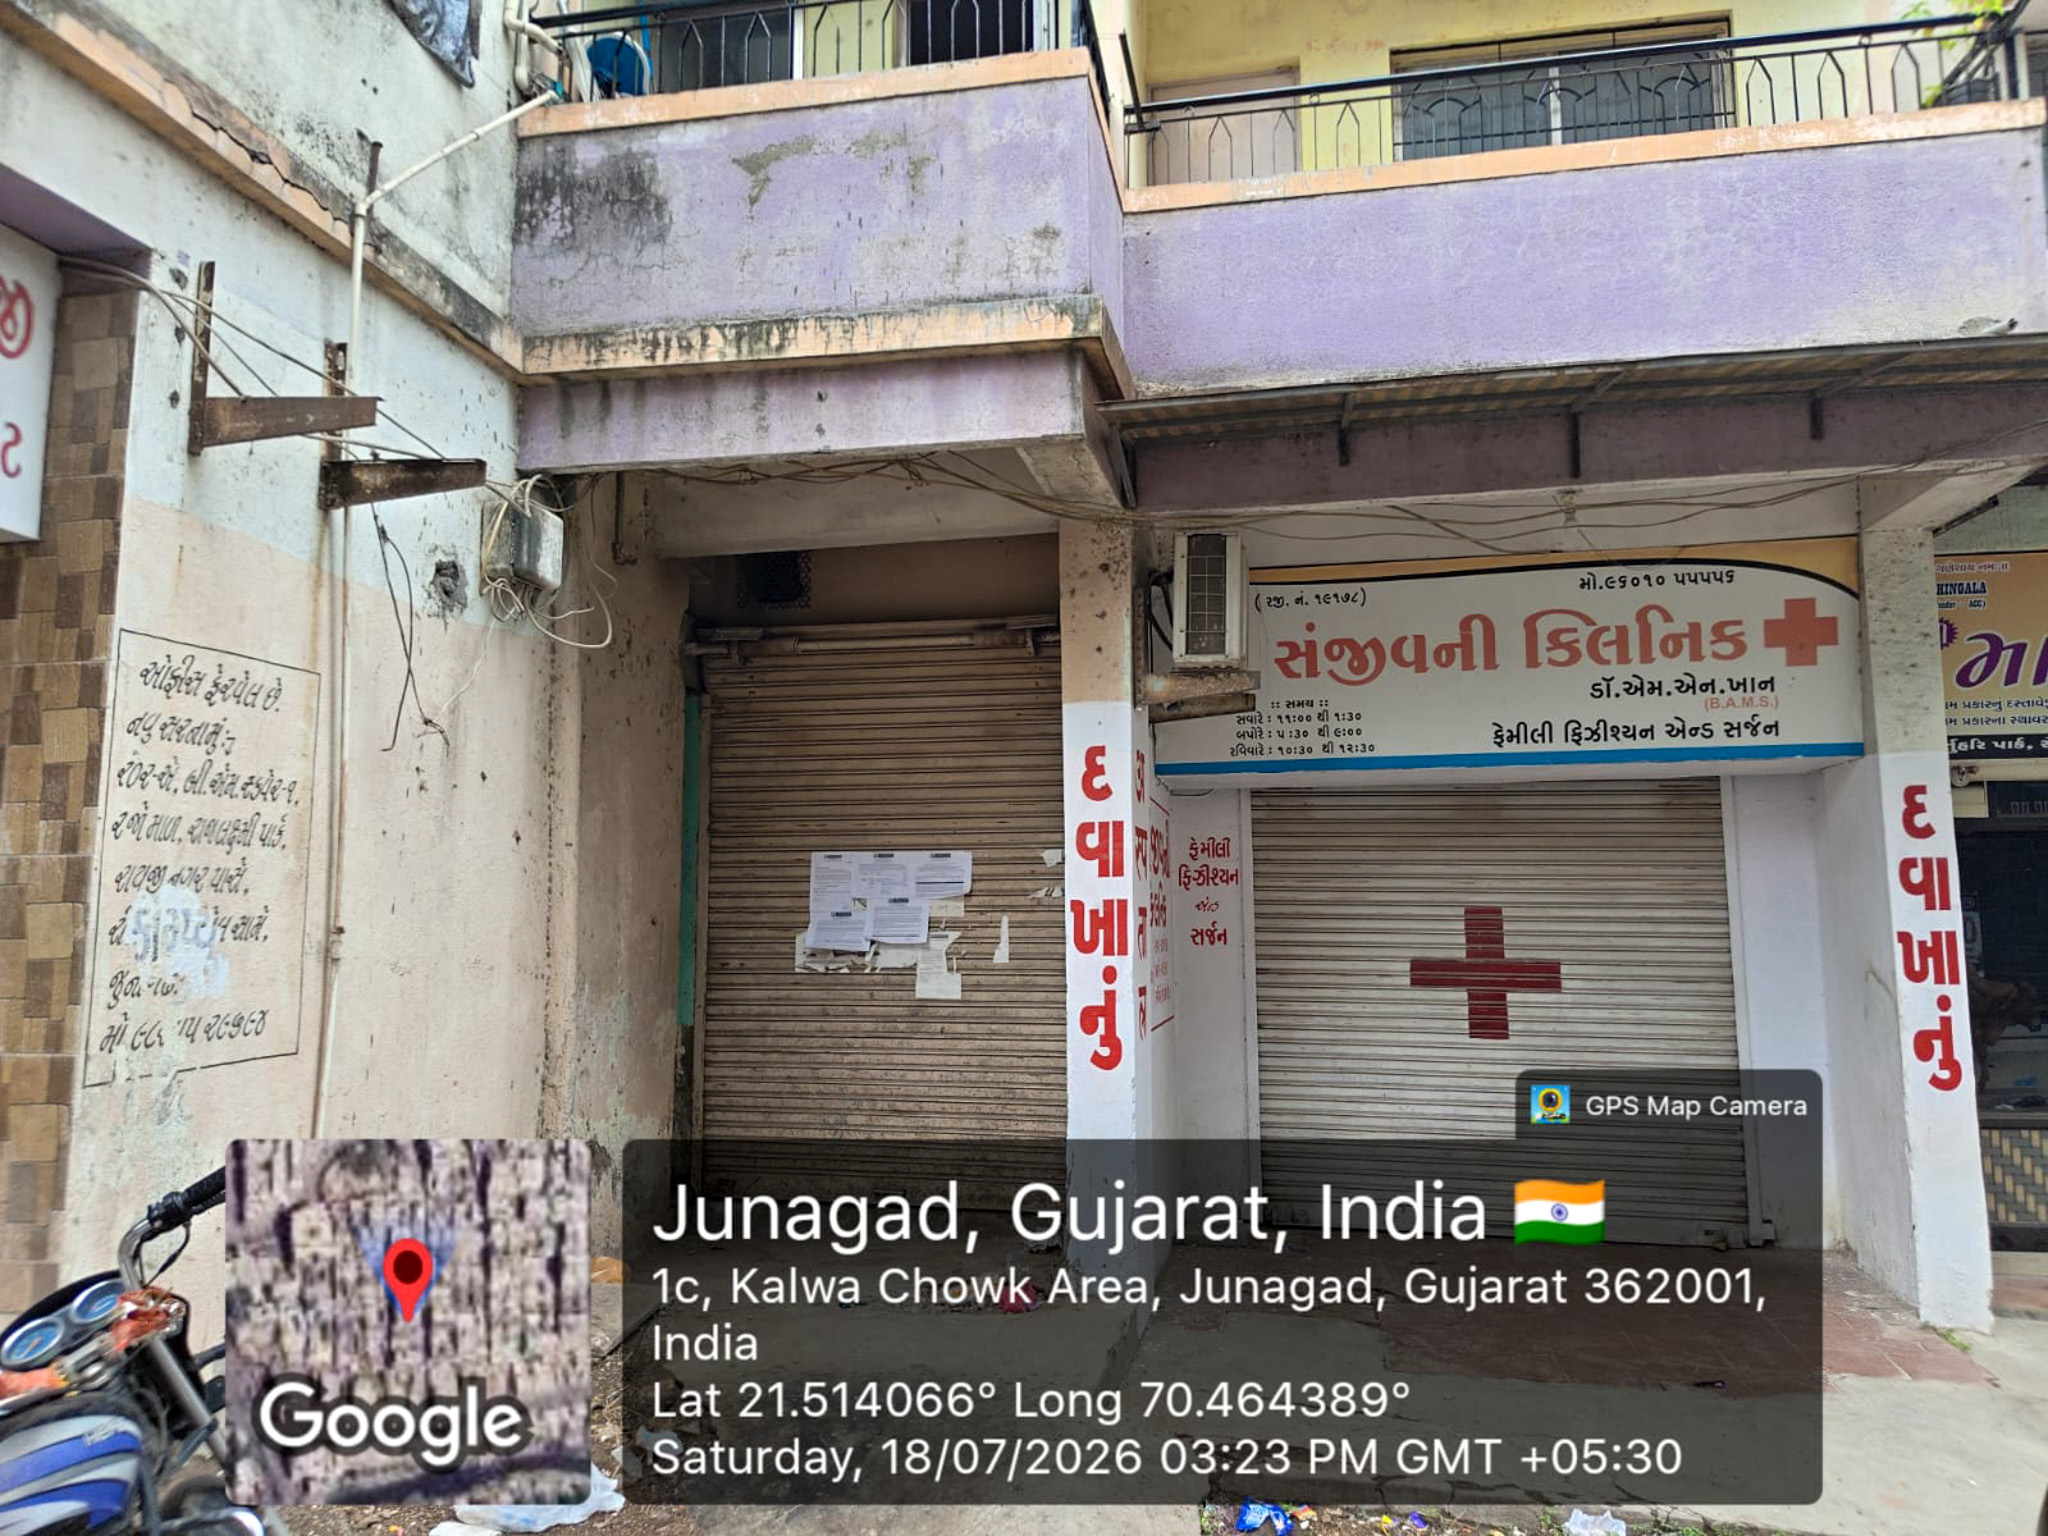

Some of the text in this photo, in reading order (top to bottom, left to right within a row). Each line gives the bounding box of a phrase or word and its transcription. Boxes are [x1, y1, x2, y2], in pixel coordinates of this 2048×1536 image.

[1274, 613, 1500, 686] સંજીવની
[1286, 699, 1314, 709] સમય
[1704, 696, 1779, 711] (B.A.M.S.)
[1723, 714, 1780, 738] સર્જન
